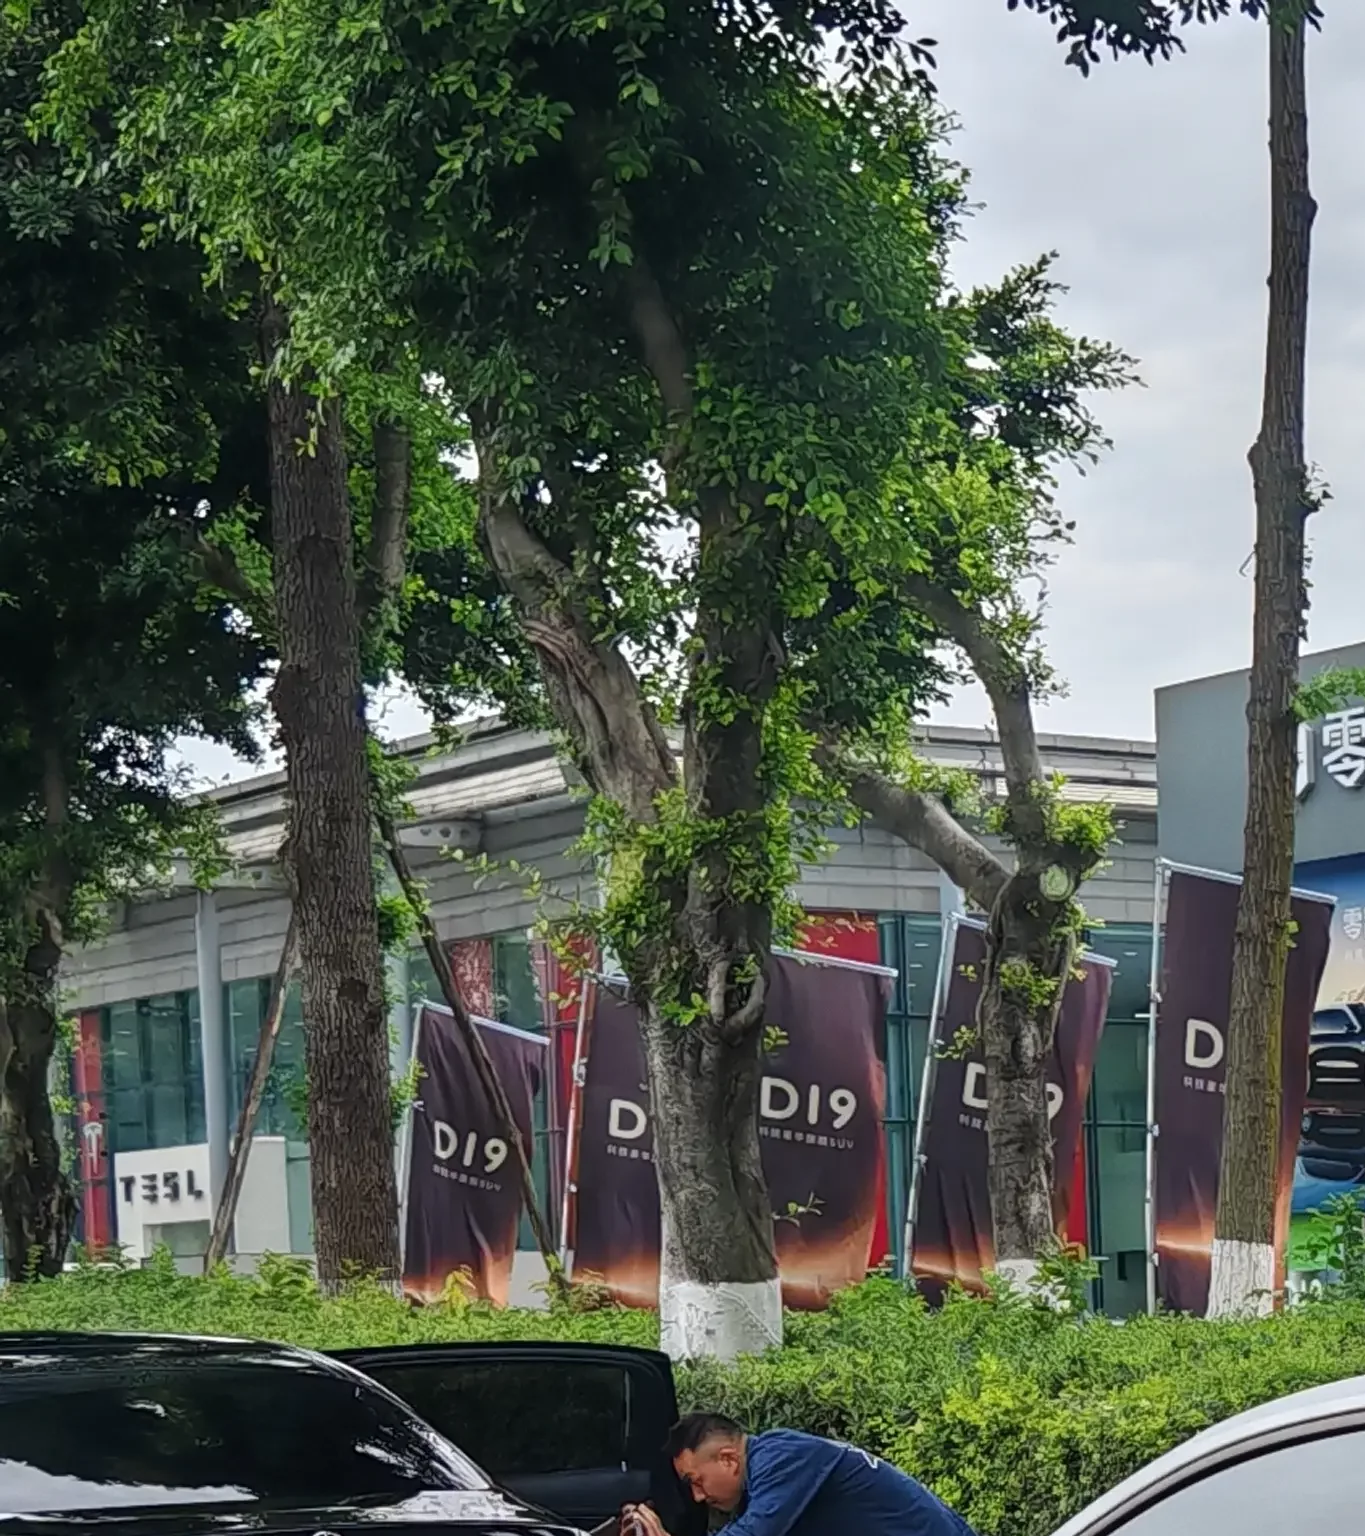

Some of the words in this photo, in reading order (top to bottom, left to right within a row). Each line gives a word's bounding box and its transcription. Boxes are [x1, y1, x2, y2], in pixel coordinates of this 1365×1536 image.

[760, 1076, 857, 1130] D19
[434, 1120, 508, 1173] D19
[119, 1169, 204, 1203] TESL
